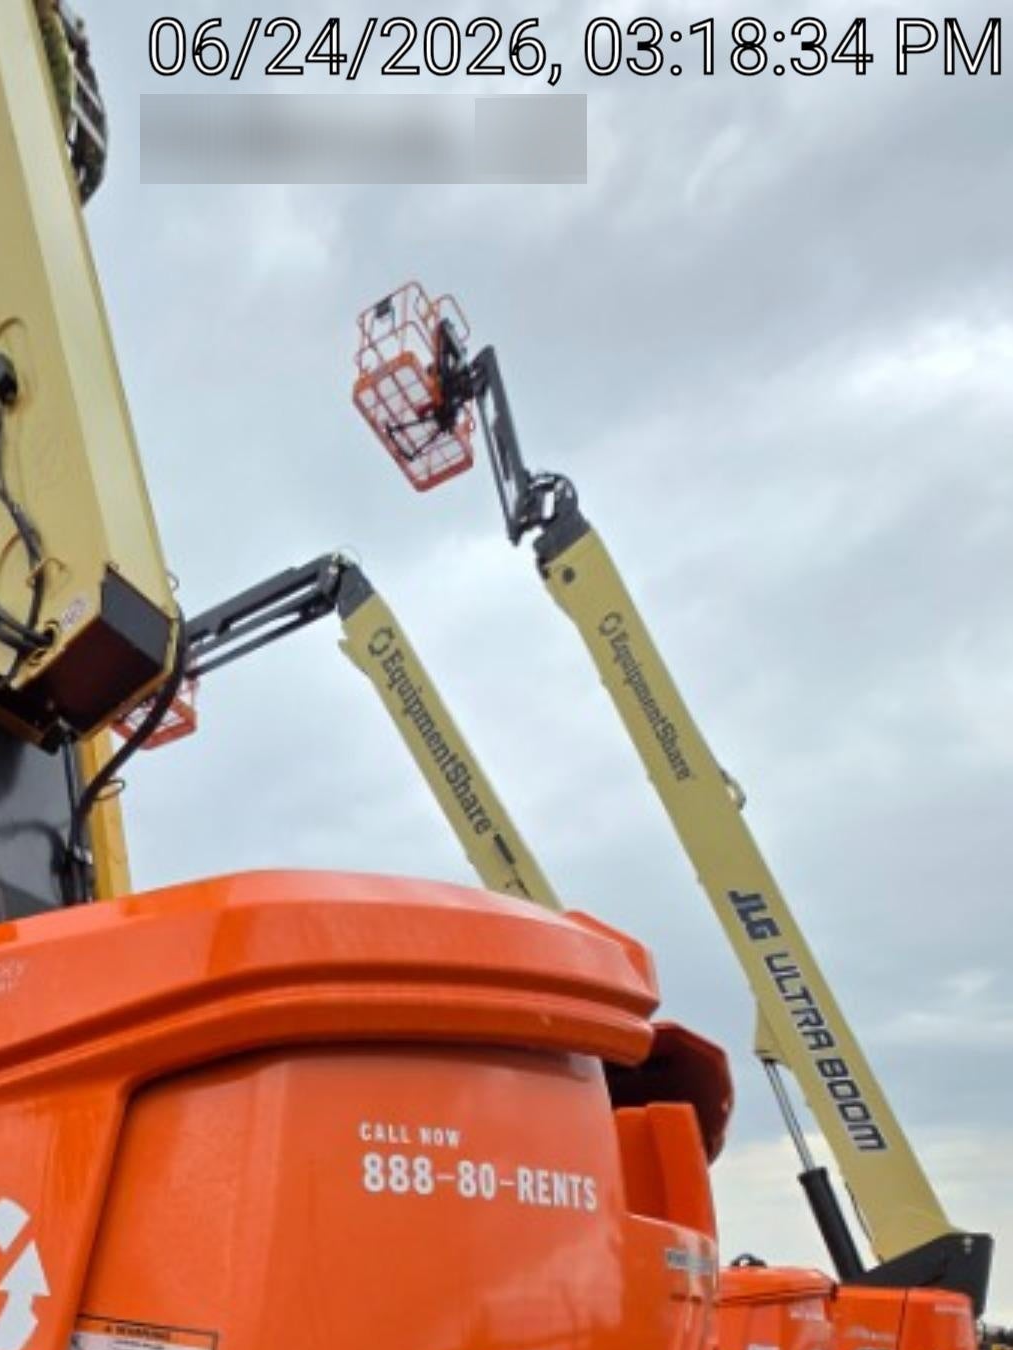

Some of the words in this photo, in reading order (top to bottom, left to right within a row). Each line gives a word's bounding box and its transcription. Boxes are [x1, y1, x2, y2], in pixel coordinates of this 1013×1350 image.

[381, 648, 492, 835] EquipmentShare
[727, 890, 781, 941] JLG
[765, 952, 834, 1050] ULTRA
[815, 1057, 887, 1151] BOOM
[359, 1121, 411, 1144] CALL
[420, 1126, 461, 1148] NOW
[362, 1151, 599, 1212] 888-80-RENTS
